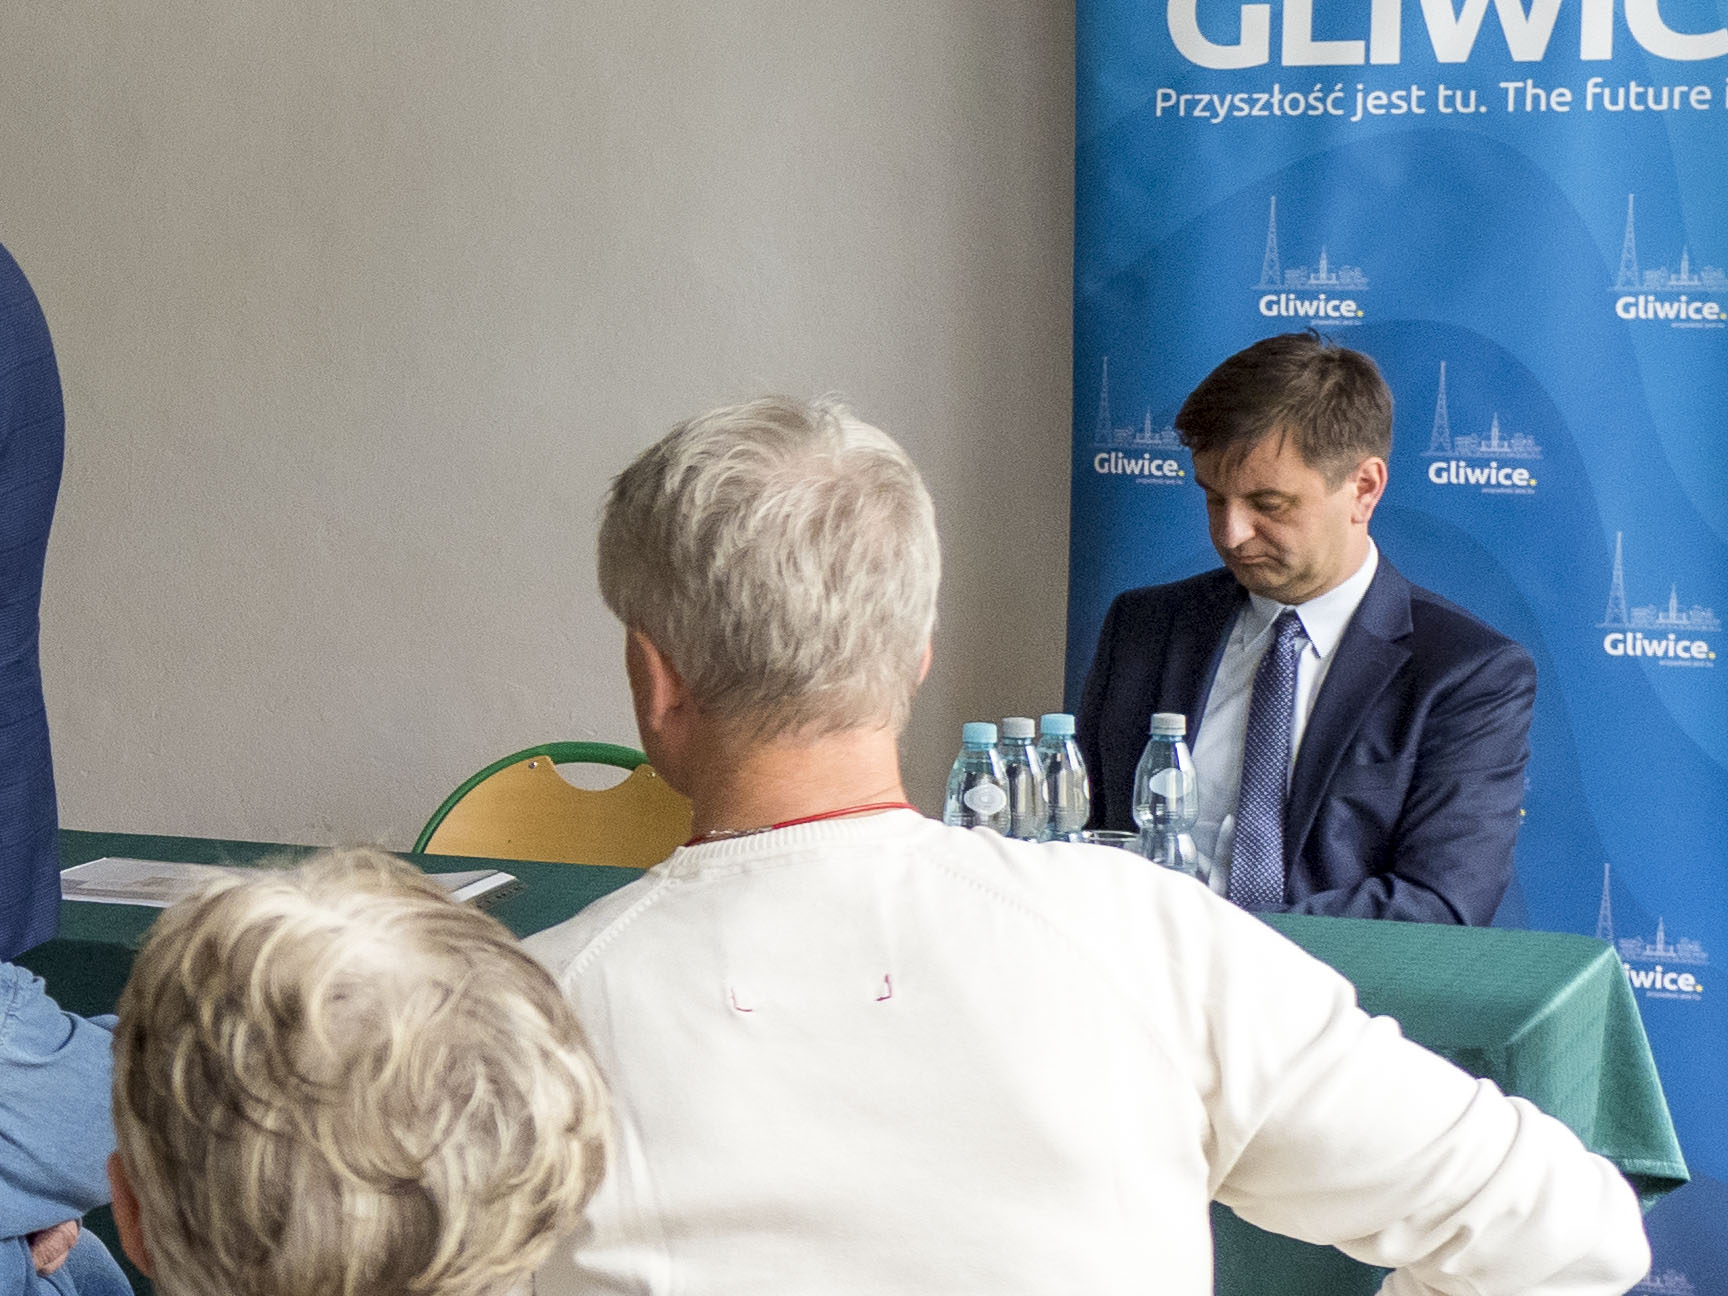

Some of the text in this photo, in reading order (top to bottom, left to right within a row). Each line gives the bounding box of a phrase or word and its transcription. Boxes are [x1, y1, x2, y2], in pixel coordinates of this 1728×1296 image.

[1154, 83, 1345, 124] Przyszłość
[1350, 83, 1426, 122] jest
[1438, 85, 1487, 114] tu.
[1499, 80, 1572, 113] The
[1585, 77, 1712, 112] future
